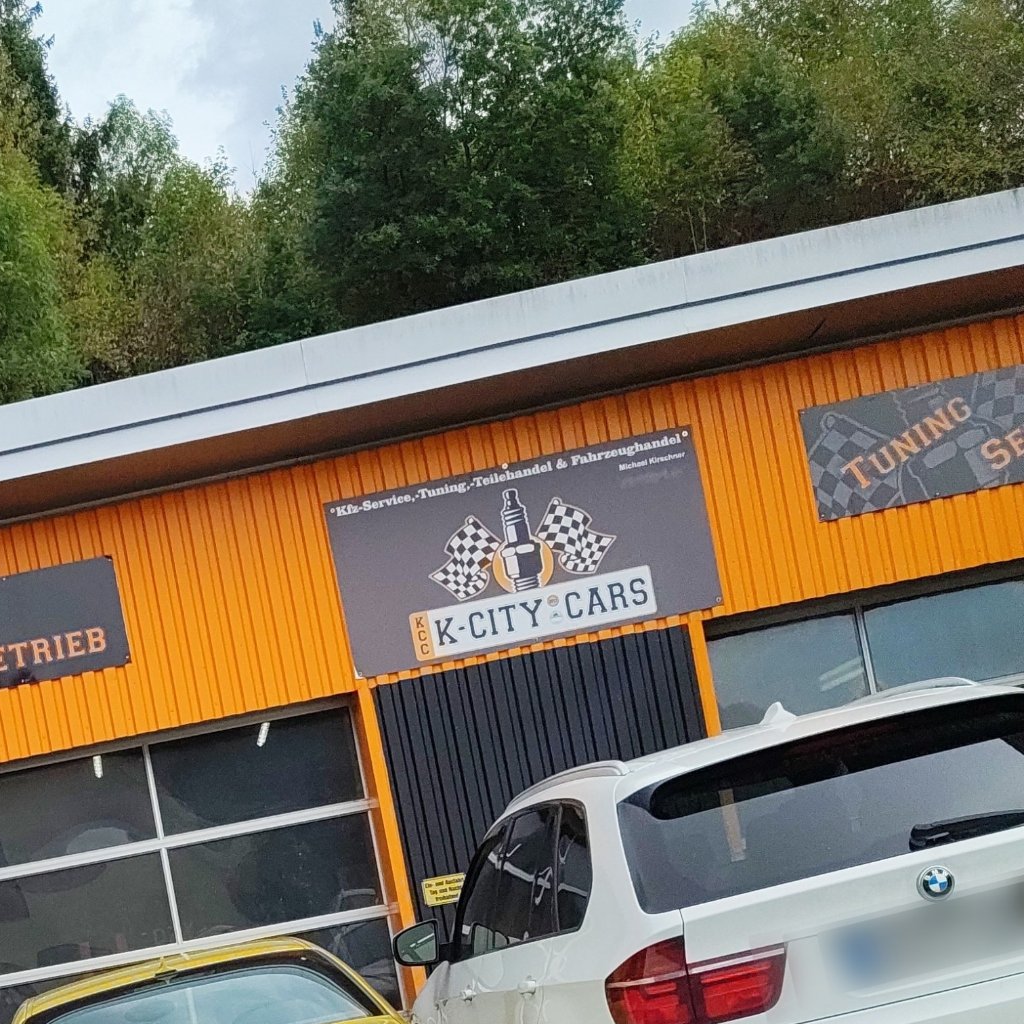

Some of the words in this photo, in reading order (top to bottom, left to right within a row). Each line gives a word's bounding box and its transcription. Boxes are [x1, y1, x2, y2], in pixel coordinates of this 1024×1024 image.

[556, 458, 568, 470] &
[571, 434, 681, 467] Fahrzeughandel
[619, 459, 647, 471] Michael
[649, 452, 685, 464] Kirschner
[840, 397, 972, 489] TUNING
[434, 598, 543, 647] K-CITY
[564, 577, 649, 620] CARS
